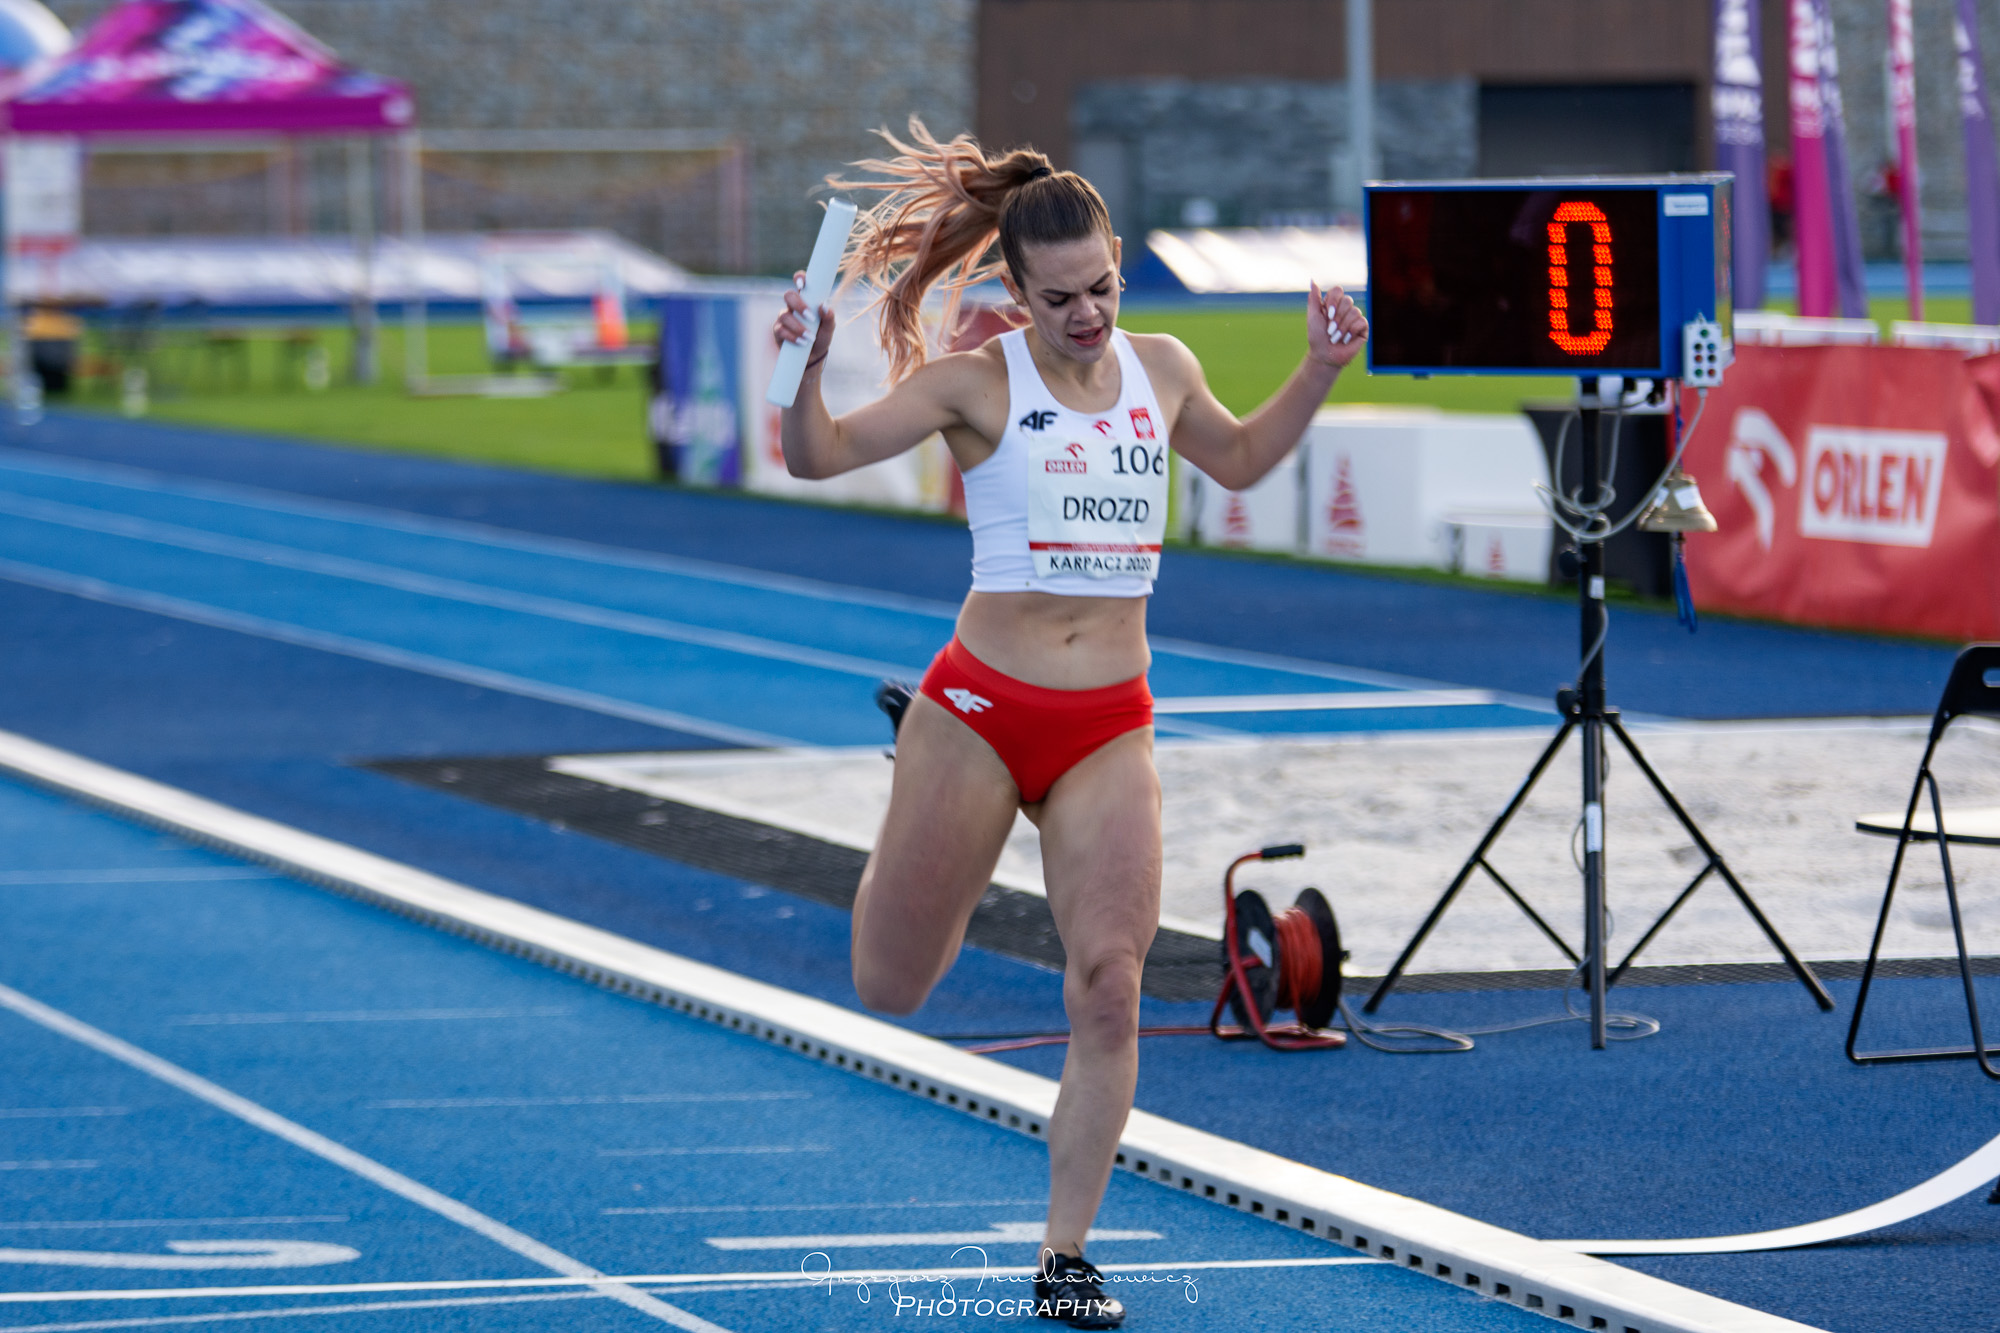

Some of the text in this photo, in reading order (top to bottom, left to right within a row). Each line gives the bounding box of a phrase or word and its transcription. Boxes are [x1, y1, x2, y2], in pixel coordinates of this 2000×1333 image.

[1547, 202, 1613, 356] 0
[1047, 460, 1085, 473] ORLEN
[1111, 444, 1164, 476] 106
[1813, 449, 1934, 526] ORLEN
[1063, 496, 1150, 523] DROZD
[1050, 555, 1121, 571] KARPACZ
[943, 687, 994, 714] 4F
